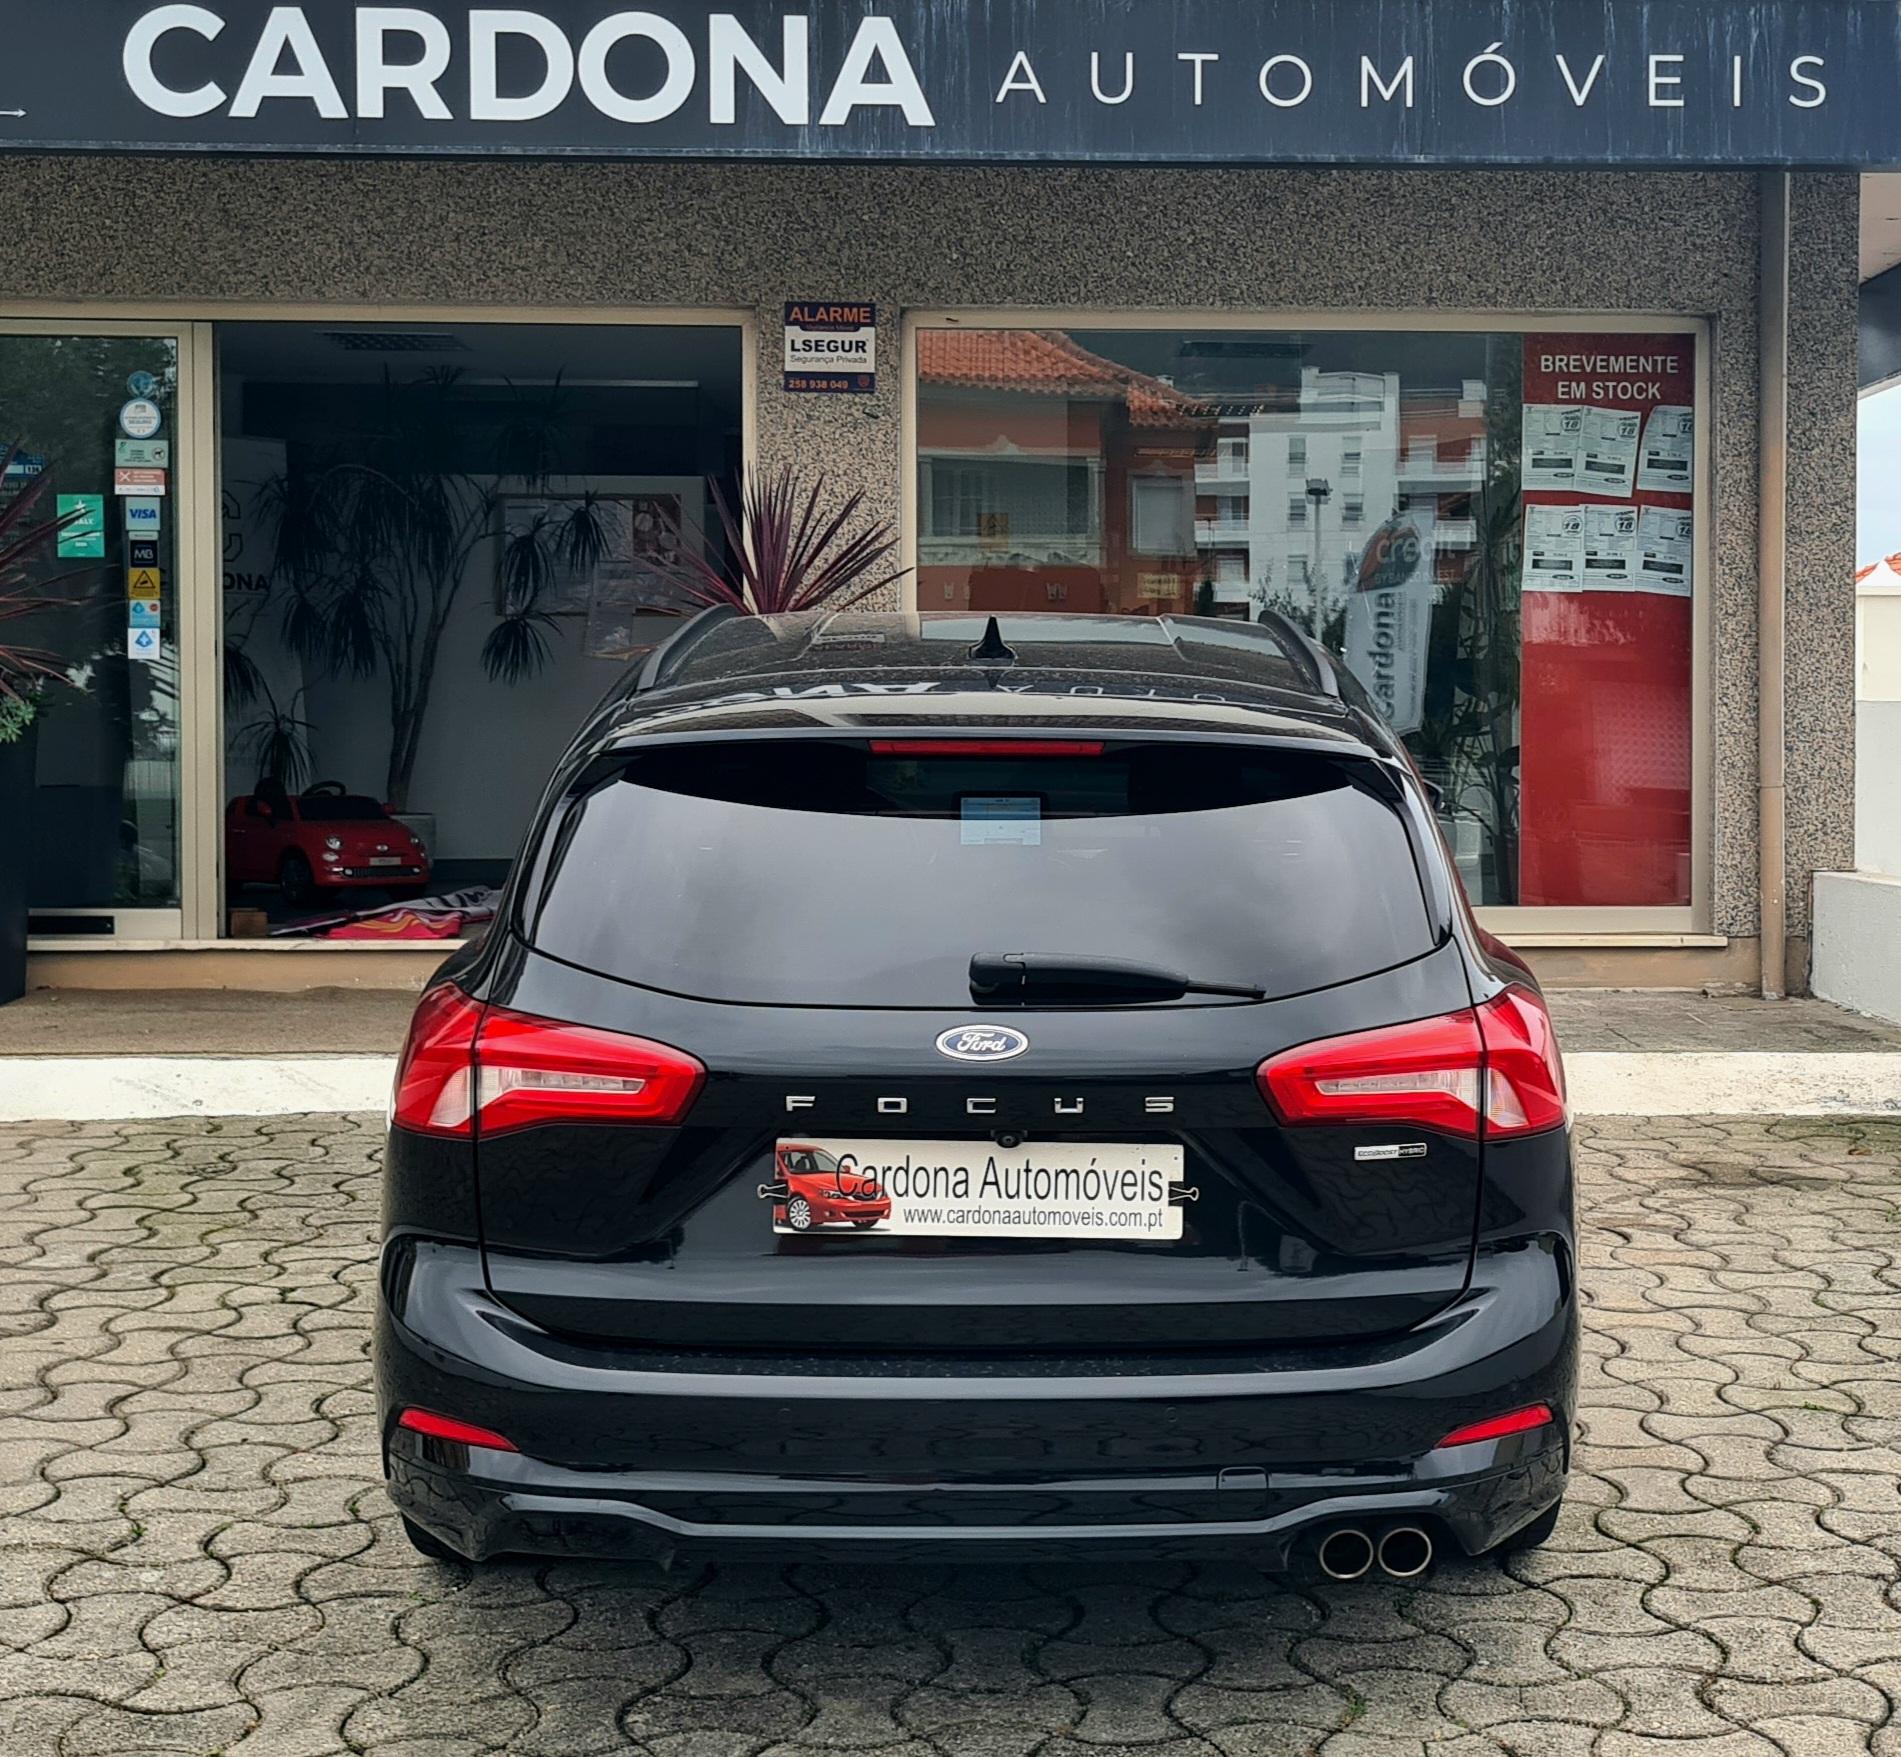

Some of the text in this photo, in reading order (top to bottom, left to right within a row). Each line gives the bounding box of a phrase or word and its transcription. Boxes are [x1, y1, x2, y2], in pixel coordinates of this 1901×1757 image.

[122, 3, 1828, 127] CARDONA AUTOMÓVEIS
[789, 306, 872, 322] ALARME
[790, 338, 868, 353] LSEGUR
[790, 355, 867, 364] Segurança Privada
[1540, 355, 1680, 374] BREVEMENTE
[1557, 381, 1661, 400] EM STOCK
[129, 508, 157, 520] VISA
[134, 548, 154, 560] MB
[956, 1031, 1007, 1053] Ford
[785, 1095, 1175, 1114] FOCUS
[836, 1153, 1164, 1202] Cardona Automóveis
[903, 1205, 1163, 1228] www.cardonaautomoveis.com.pt
